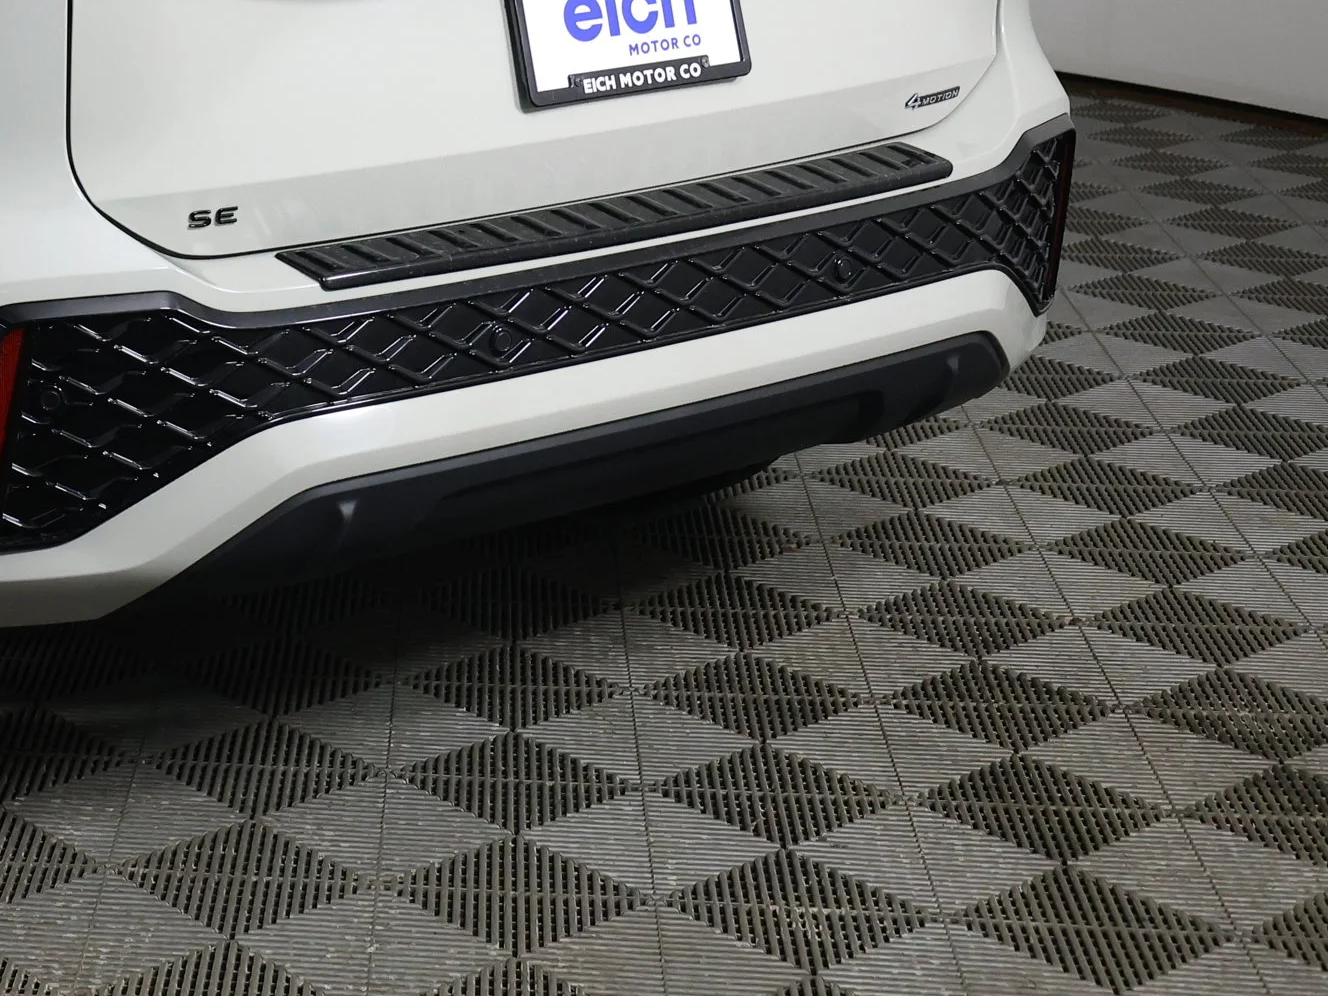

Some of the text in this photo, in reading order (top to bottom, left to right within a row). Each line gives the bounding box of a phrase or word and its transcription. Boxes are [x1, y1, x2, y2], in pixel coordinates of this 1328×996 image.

[629, 34, 701, 56] MOTOR CO
[583, 63, 702, 94] EICH MOTOR CO
[905, 86, 960, 109] 4MOTION
[188, 206, 238, 229] SE
